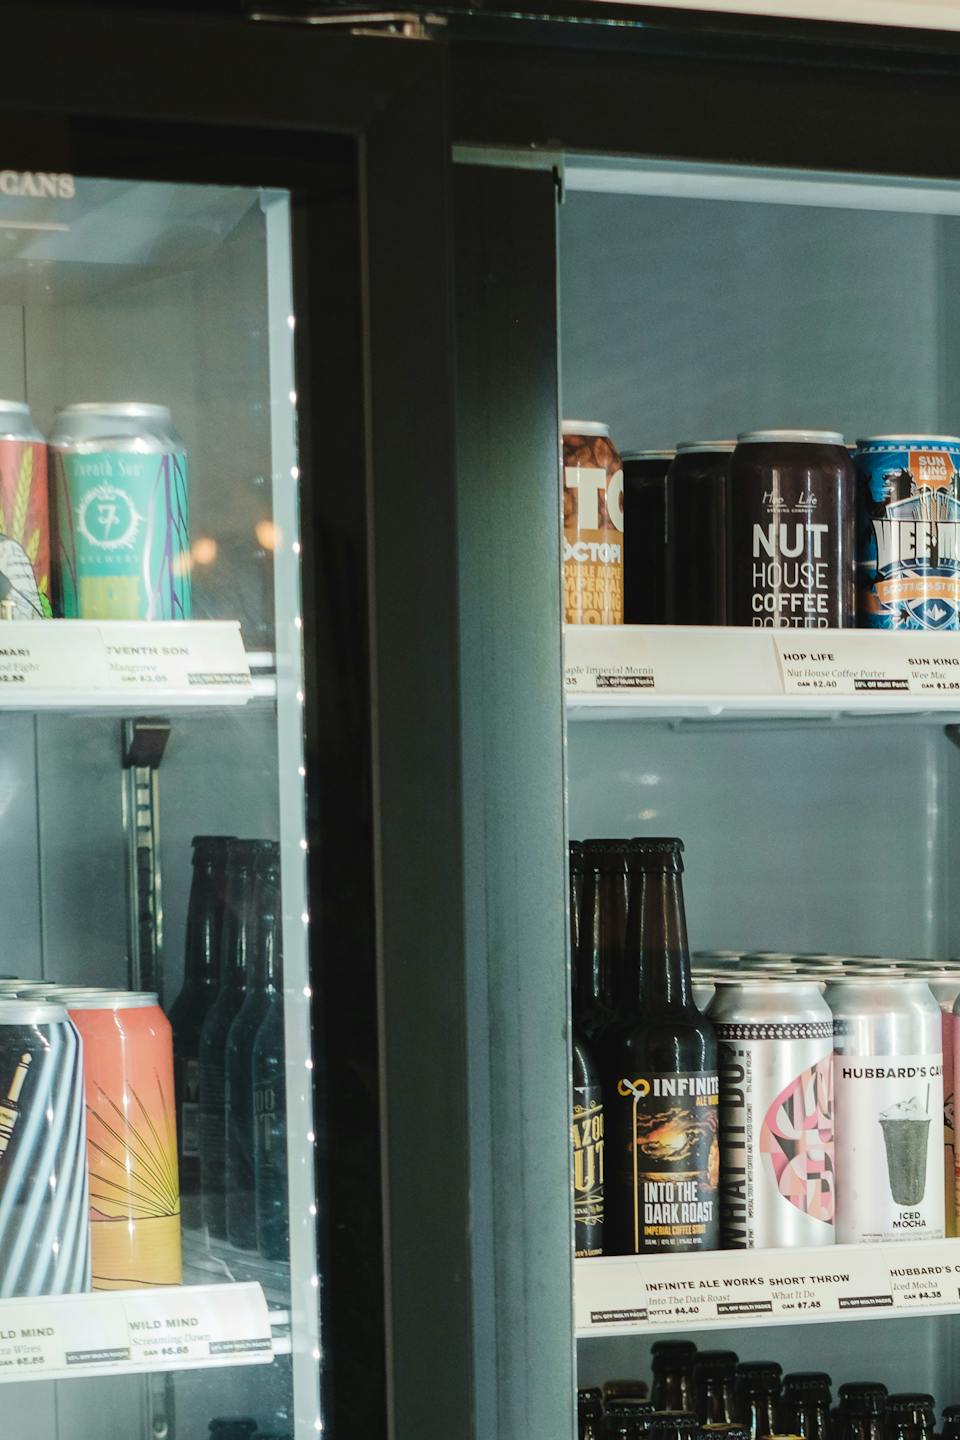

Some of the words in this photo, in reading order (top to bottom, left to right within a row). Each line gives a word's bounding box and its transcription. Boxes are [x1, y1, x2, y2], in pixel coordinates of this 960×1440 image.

[918, 456, 945, 467] SUN
[920, 466, 947, 477] KING
[753, 523, 829, 558] NUT
[753, 563, 829, 589] HOUSE
[752, 593, 829, 614] COFFEE
[163, 647, 189, 656] SON
[783, 653, 807, 662] HOP
[811, 653, 835, 662] LIFE
[908, 658, 930, 666] SUN
[934, 658, 960, 666] KING
[787, 669, 803, 678] Nut
[804, 669, 830, 678] House
[831, 669, 858, 678] Coffee
[860, 670, 886, 679] Porter
[911, 671, 928, 679] Wee
[929, 671, 947, 679] Mac
[719, 1041, 746, 1108] DO?
[842, 1066, 926, 1079] HUBBARD'S
[719, 1122, 746, 1150] IT
[644, 1181, 674, 1203] INTO
[676, 1180, 699, 1202] THE
[644, 1202, 680, 1224] DARK
[681, 1200, 714, 1224] ROAST
[719, 1163, 747, 1250] WHAT
[899, 1211, 921, 1220] ICED
[892, 1219, 926, 1228] MOCHA
[890, 1265, 952, 1277] HUBBARD'S
[645, 1280, 694, 1292] INFINITE
[699, 1279, 721, 1289] ALE
[723, 1276, 765, 1287] WORKS
[769, 1276, 805, 1286] SHORT
[809, 1274, 850, 1285] THROW
[893, 1281, 910, 1291] Iced
[911, 1281, 938, 1290] Mocha
[648, 1296, 666, 1306] Into
[667, 1295, 683, 1305] The
[685, 1293, 706, 1304] Dark
[707, 1293, 730, 1302] Roast
[772, 1290, 789, 1300] What
[799, 1290, 815, 1299] Do
[129, 1321, 162, 1331] WILD
[165, 1317, 199, 1328] MIND
[21, 1327, 55, 1338] MIND
[132, 1335, 183, 1348] Screaming
[184, 1332, 212, 1344] Dawn
